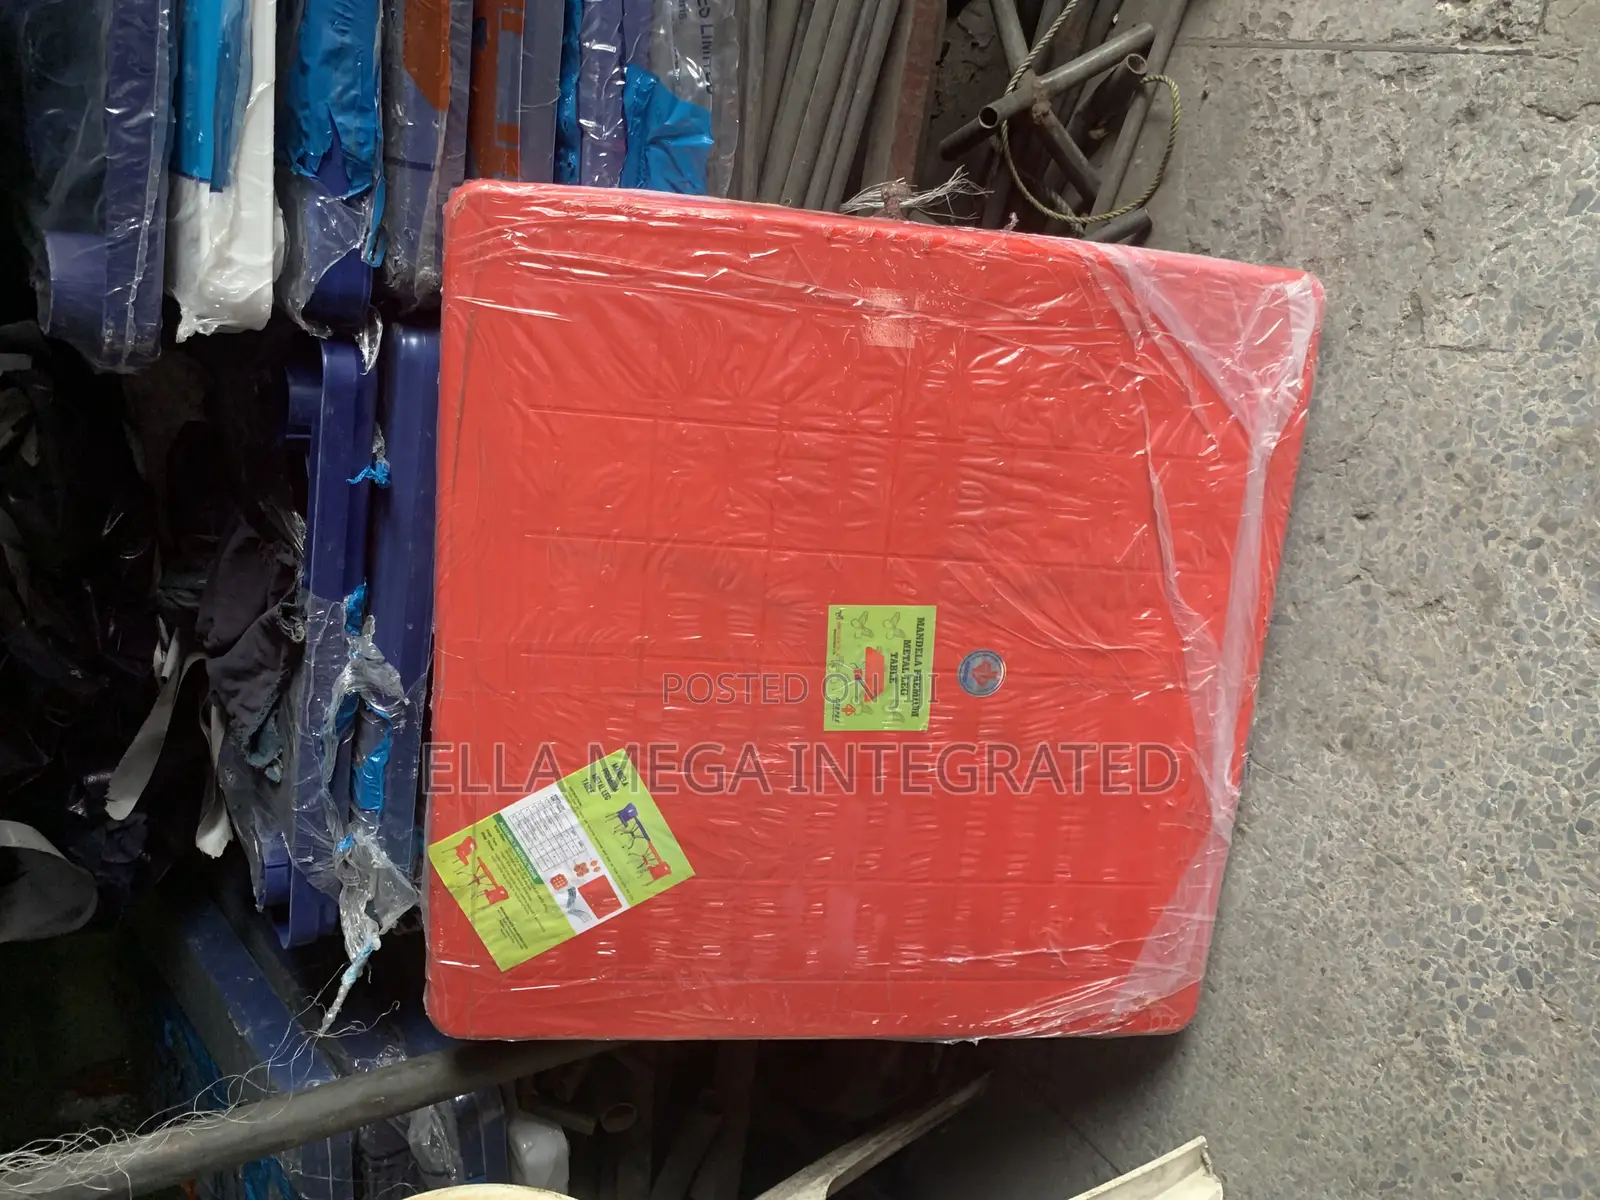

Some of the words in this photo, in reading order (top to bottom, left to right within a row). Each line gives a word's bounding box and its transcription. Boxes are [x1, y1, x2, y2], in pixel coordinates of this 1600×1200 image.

[901, 640, 912, 673] METAL
[914, 617, 925, 666] MANDELA
[889, 652, 899, 684] TABLE
[900, 676, 909, 696] LEG
